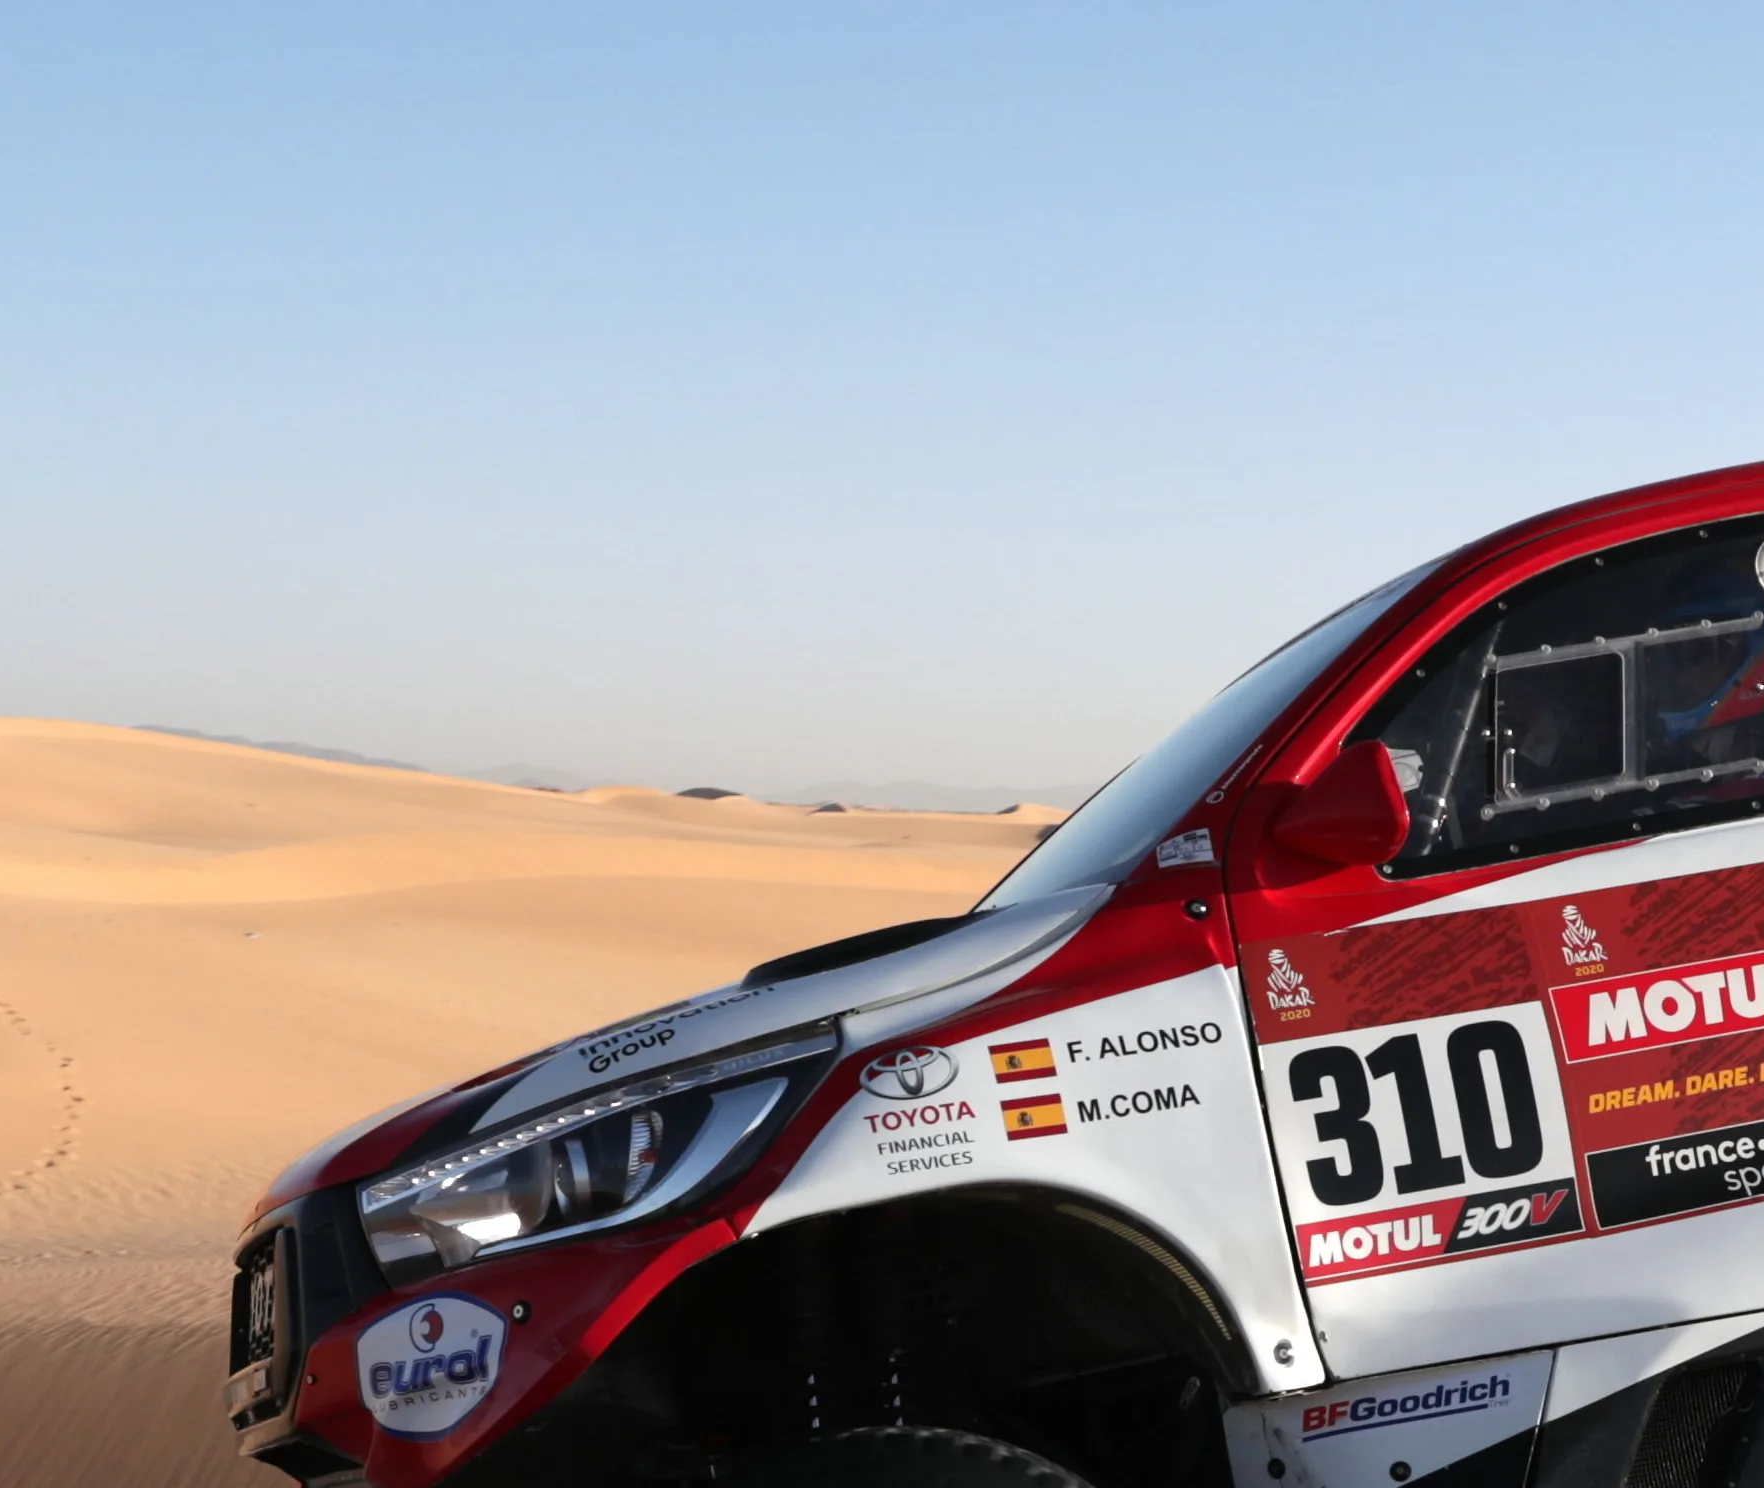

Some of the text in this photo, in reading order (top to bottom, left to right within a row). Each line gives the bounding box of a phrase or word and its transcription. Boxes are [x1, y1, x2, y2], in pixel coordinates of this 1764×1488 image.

[1562, 942, 1608, 966] DAKAR
[1575, 963, 1604, 977] 2020
[1266, 986, 1316, 1010] DAKAR
[1279, 1008, 1311, 1022] 2020
[588, 1028, 676, 1074] Group
[1067, 1022, 1223, 1063] F. ALONSO
[1077, 1083, 1200, 1123] M.COMA
[1588, 1078, 1680, 1114] DREAM.
[1686, 1067, 1754, 1096] DARE.
[864, 1101, 976, 1133] TOYOTA
[1288, 1019, 1543, 1206] 310
[877, 1131, 974, 1156] FINANCIAL
[887, 1151, 973, 1175] SERVICES
[1308, 1188, 1569, 1267] MOTUL 300V
[370, 1335, 492, 1398] eurol
[372, 1386, 487, 1414] LUBRICANTS
[1302, 1375, 1510, 1433] BFGoodrich
